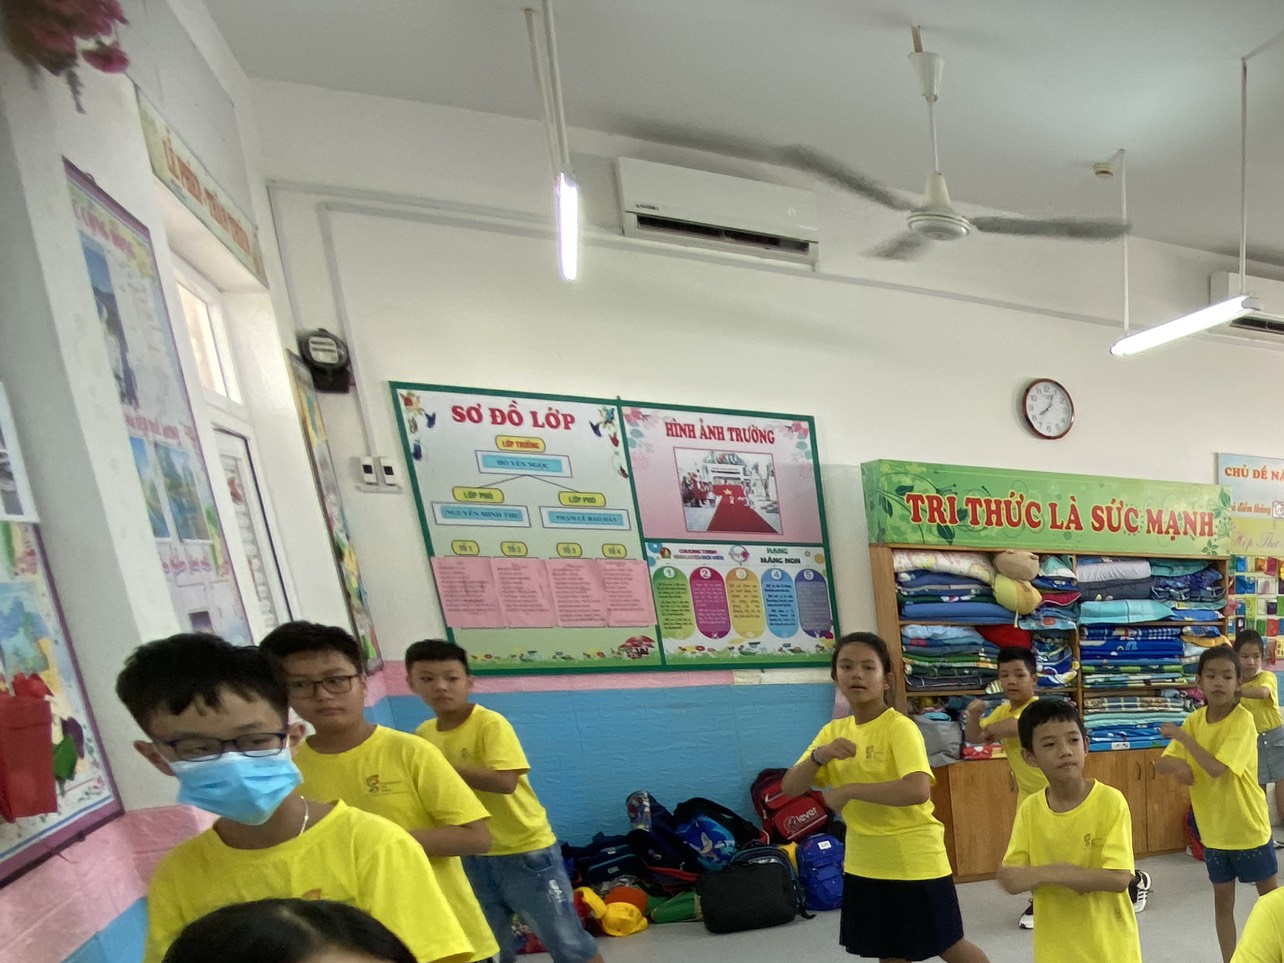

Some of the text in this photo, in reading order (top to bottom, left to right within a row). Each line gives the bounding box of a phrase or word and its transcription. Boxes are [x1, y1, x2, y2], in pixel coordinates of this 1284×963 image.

[451, 400, 576, 431] SƠ ĐỒ LỚP
[665, 418, 776, 445] HÌNH ẢNH TRƯỜNG
[1224, 464, 1250, 478] CHỦ
[905, 491, 1215, 541] TRI THỨC LÀ SỨC MẠNH
